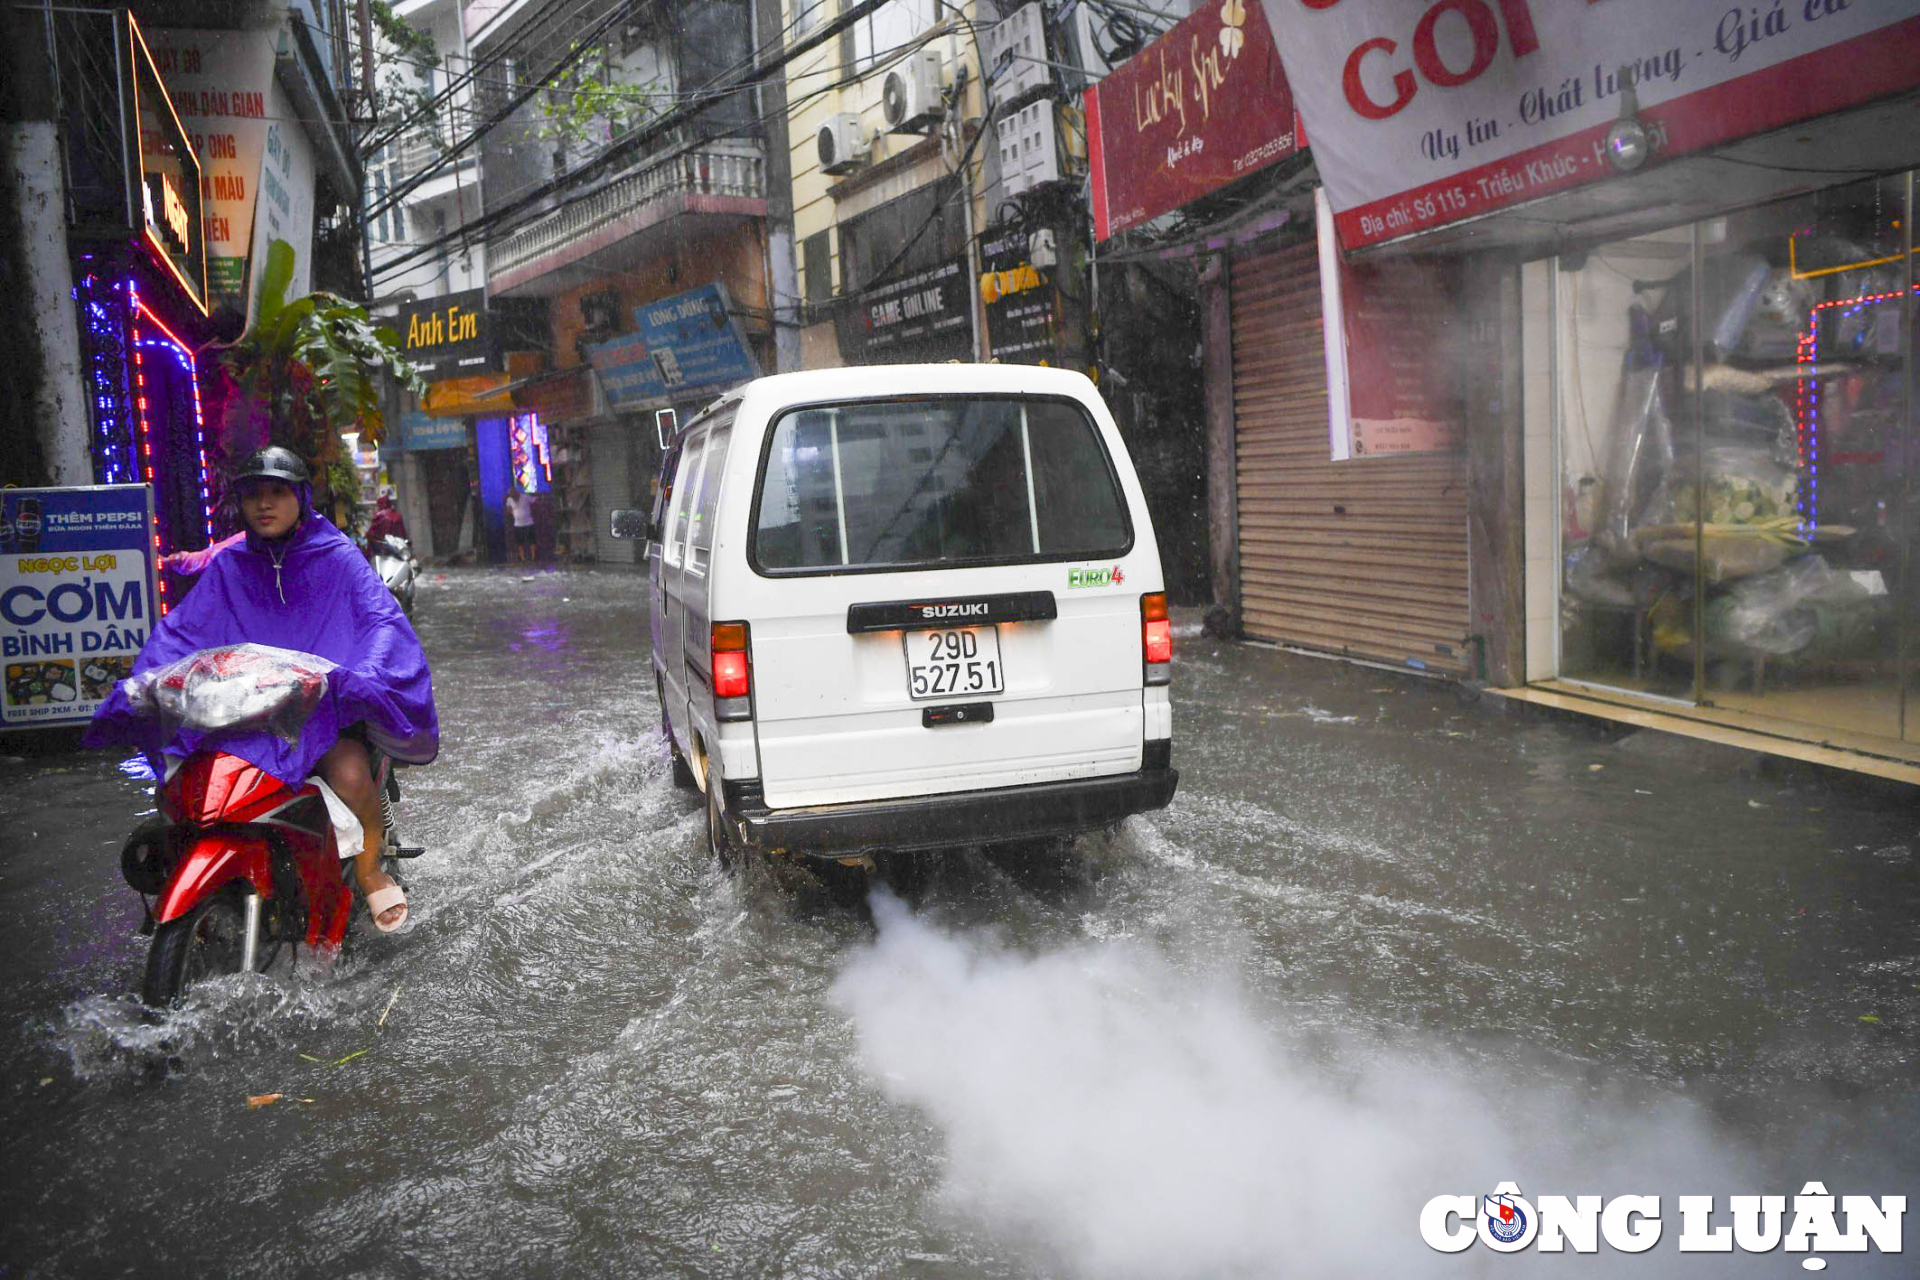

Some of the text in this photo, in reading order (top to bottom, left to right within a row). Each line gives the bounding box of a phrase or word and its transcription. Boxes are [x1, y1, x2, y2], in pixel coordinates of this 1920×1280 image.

[1136, 34, 1226, 139] Lucky Spa
[232, 91, 265, 117] GIAN
[1421, 129, 1461, 161] Uy
[1467, 117, 1500, 147] tín
[1518, 76, 1584, 126] Chất
[214, 170, 245, 201] MÀU
[1360, 214, 1385, 237] Địa
[1414, 192, 1437, 220] Số
[1437, 187, 1467, 213] 115
[1477, 168, 1525, 202] Triều
[1527, 152, 1578, 188] Khúc
[871, 286, 944, 328] GAME ONLINE
[407, 305, 478, 349] Anh Em
[46, 511, 93, 524] THÊM
[96, 512, 142, 522] PEPSI
[18, 554, 117, 575] NGỌC LỢI
[1068, 565, 1124, 588] EURO4
[0, 577, 144, 626] CƠM
[922, 603, 989, 619] SUZUKI
[2, 624, 145, 657] BÌNH DÂN
[928, 631, 977, 661] 29D
[912, 660, 998, 695] 527.51
[8, 708, 27, 717] FREE
[30, 707, 50, 716] SHIP
[52, 706, 71, 714] 2KM
